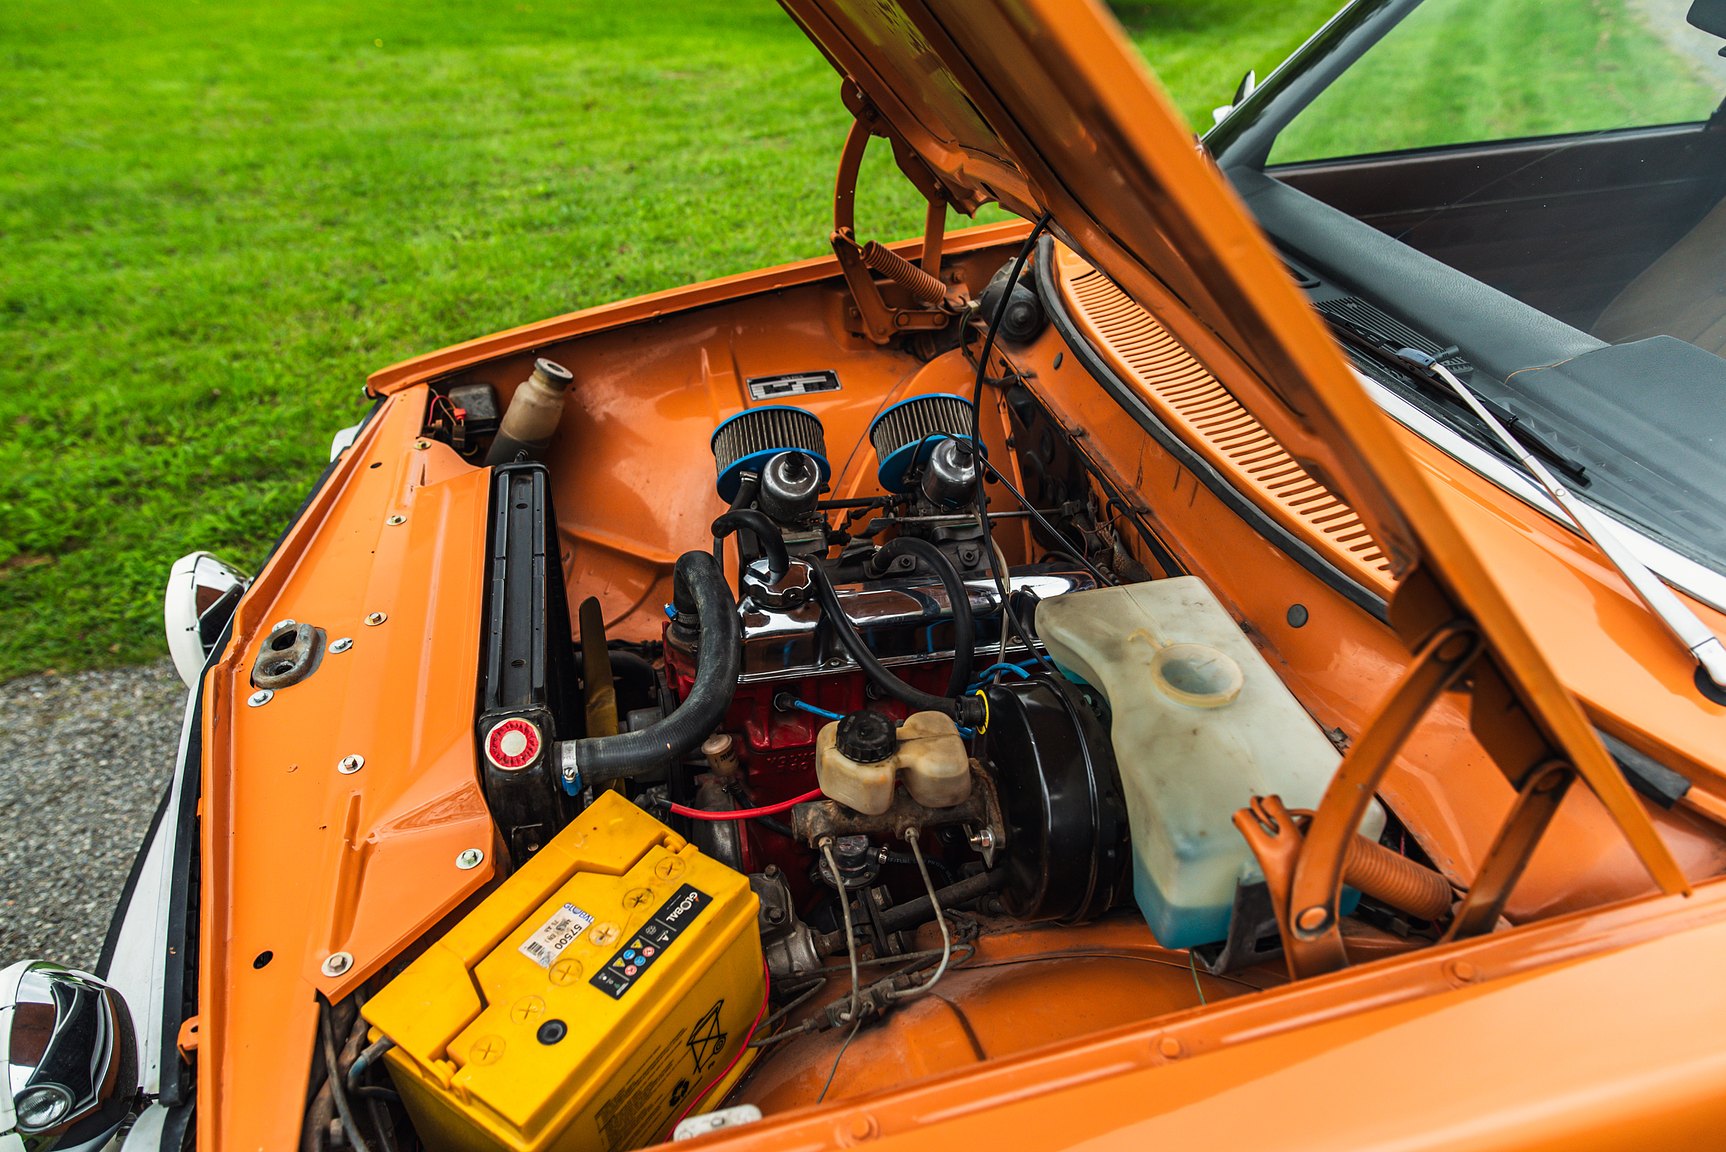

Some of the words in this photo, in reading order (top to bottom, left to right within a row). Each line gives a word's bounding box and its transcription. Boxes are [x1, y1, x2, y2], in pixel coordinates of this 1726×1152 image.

[563, 902, 594, 923] GLOBAL
[665, 892, 698, 922] GLOBAL
[555, 924, 582, 950] 57500
